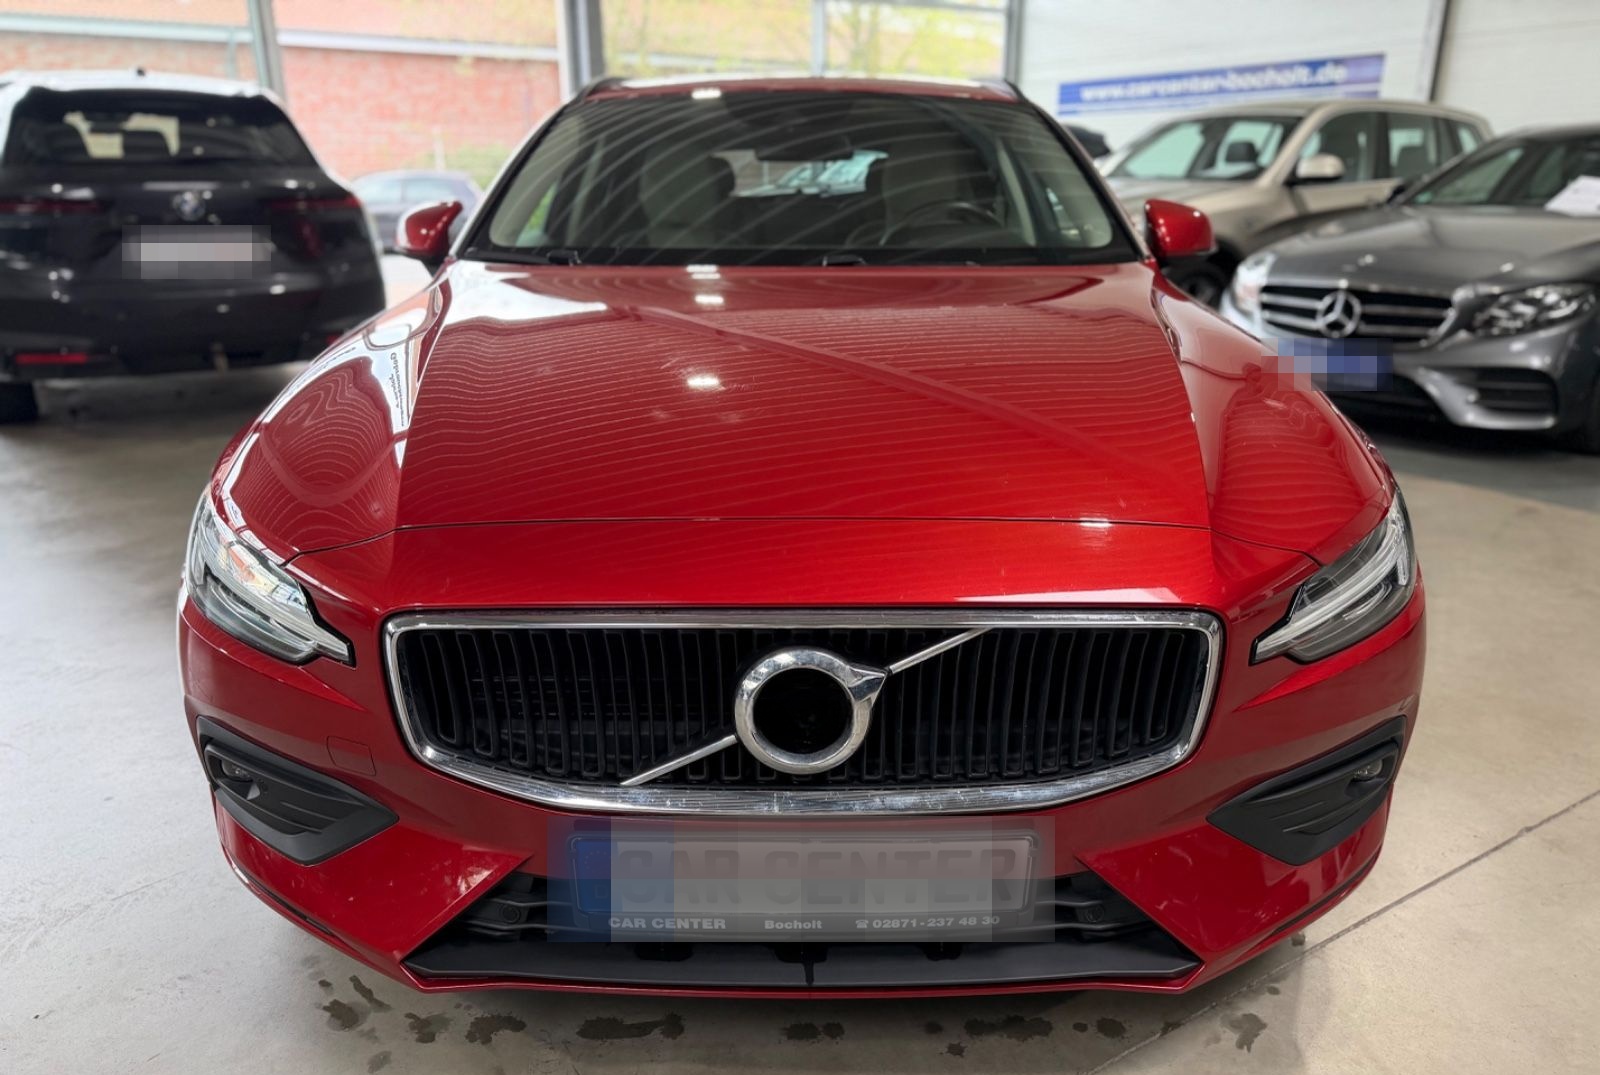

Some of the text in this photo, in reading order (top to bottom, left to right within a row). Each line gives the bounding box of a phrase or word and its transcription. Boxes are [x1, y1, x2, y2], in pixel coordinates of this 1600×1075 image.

[619, 849, 1017, 905] CAR CENTER
[608, 916, 647, 929] CAR
[651, 917, 727, 930] CENTER
[764, 919, 823, 930] Bocholt
[958, 916, 978, 926] 48
[981, 915, 1000, 926] 30
